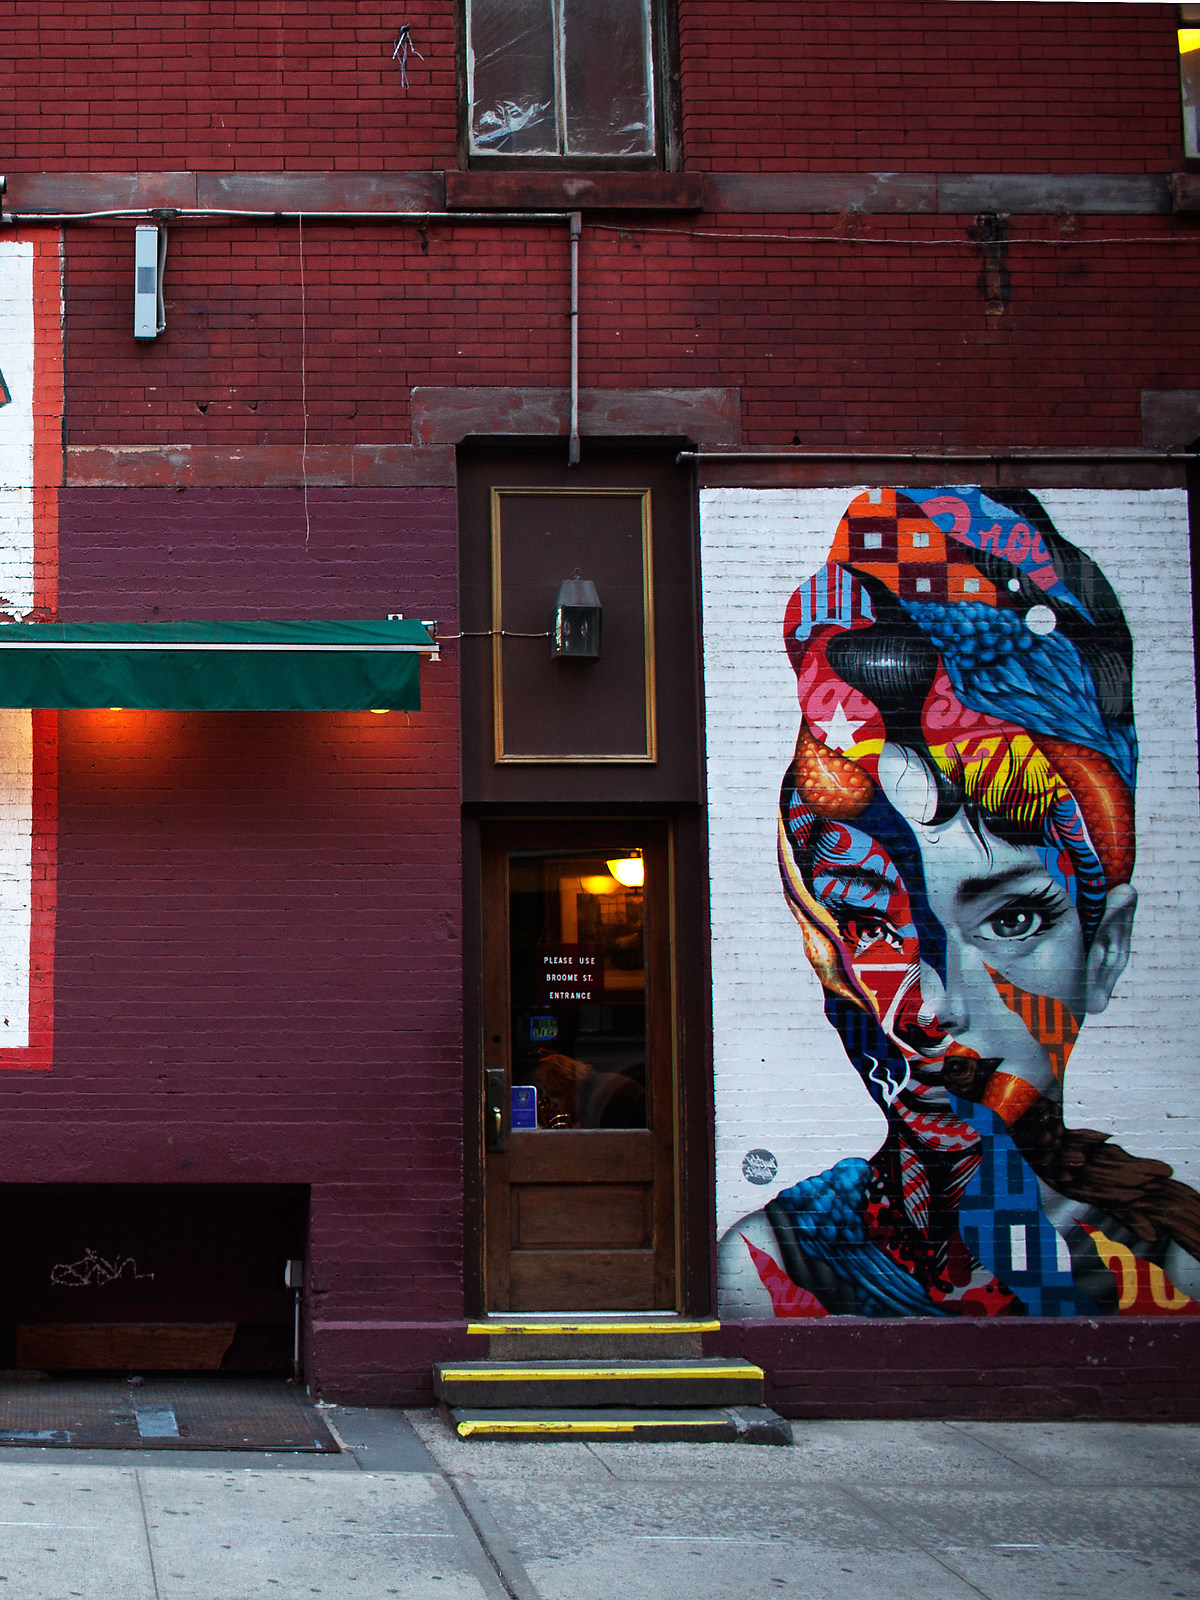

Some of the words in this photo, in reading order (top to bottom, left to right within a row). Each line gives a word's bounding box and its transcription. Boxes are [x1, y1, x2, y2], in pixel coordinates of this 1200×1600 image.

[543, 956, 573, 965] PLEASE
[578, 957, 596, 965] USE
[546, 973, 579, 982] BROOME
[582, 974, 594, 982] ST.
[549, 991, 592, 1000] ENTRANCE
